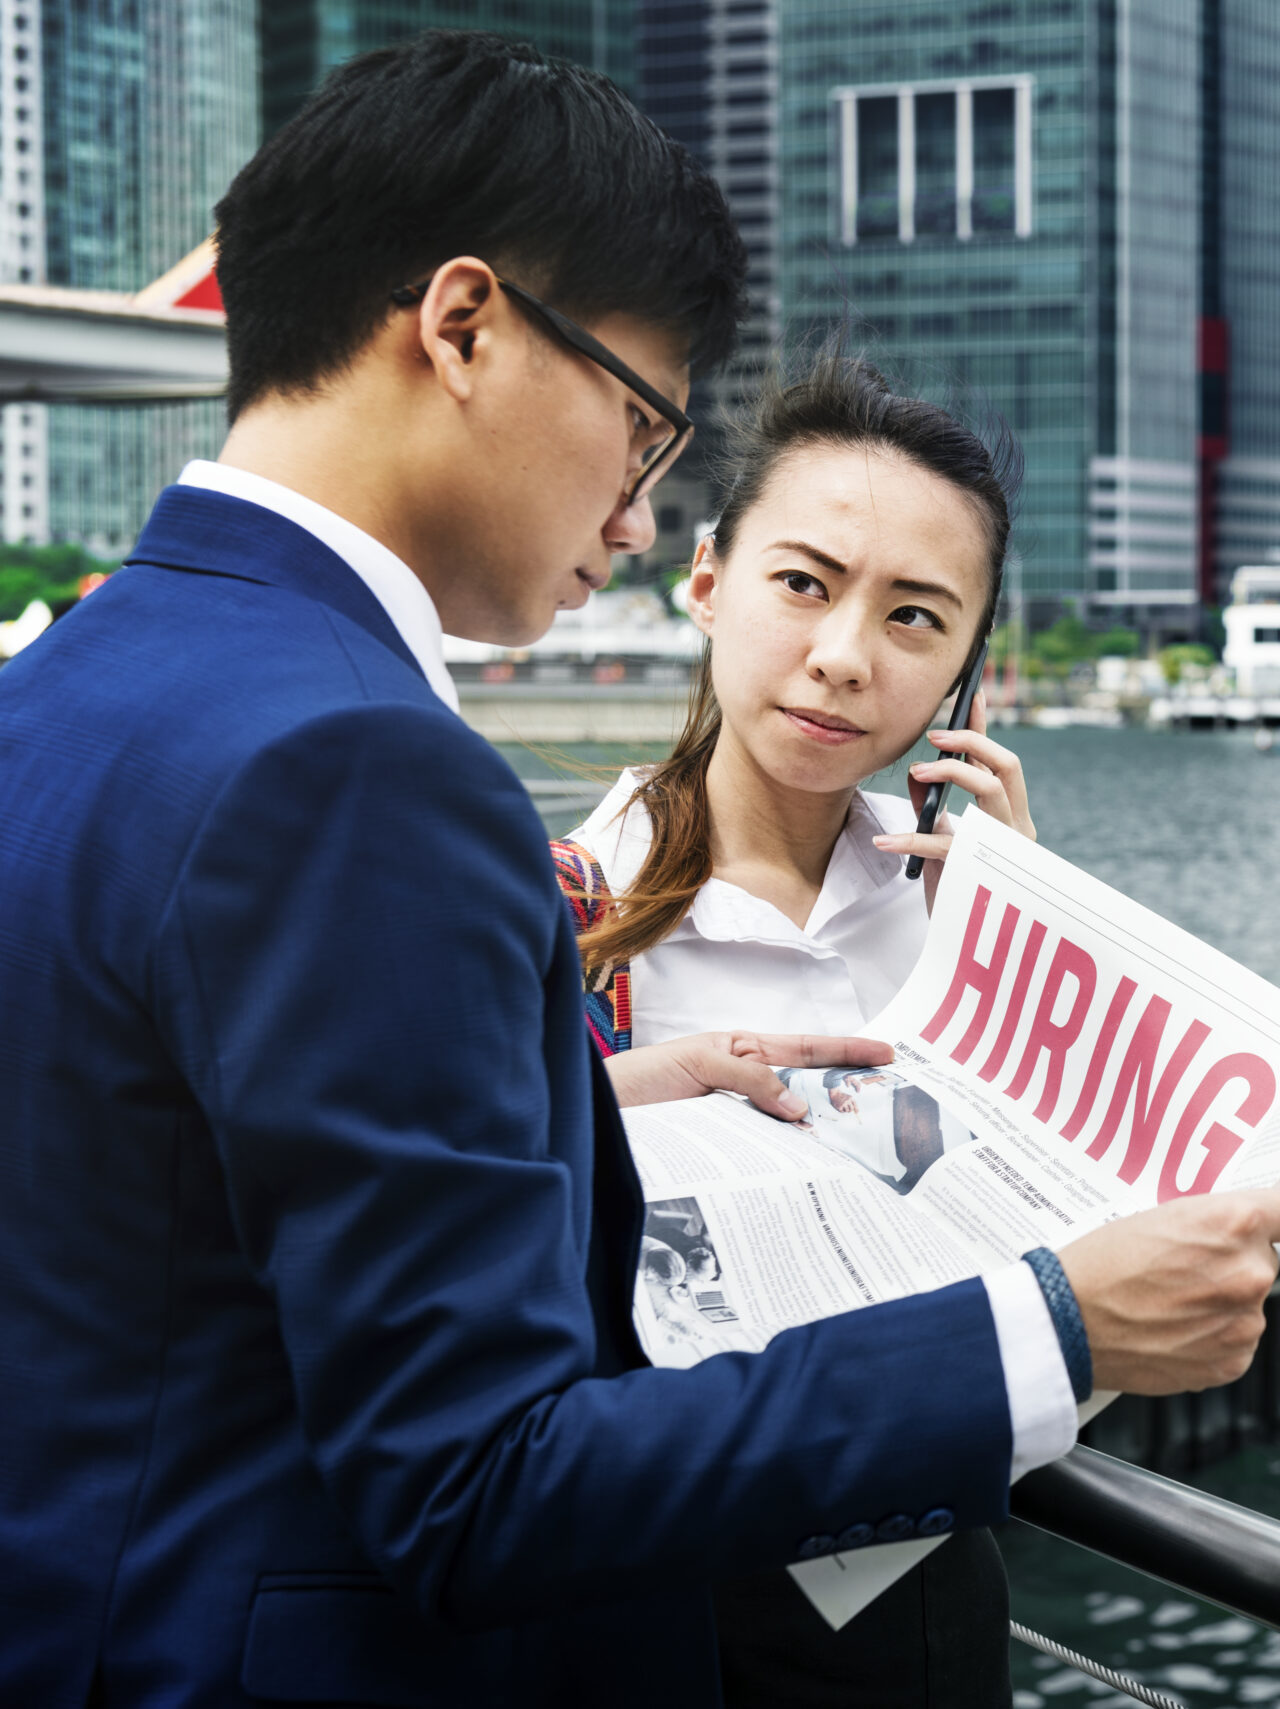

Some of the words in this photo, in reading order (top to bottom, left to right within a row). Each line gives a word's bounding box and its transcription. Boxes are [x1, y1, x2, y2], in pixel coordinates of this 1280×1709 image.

[894, 1041, 931, 1064] EMPLOYMENT
[919, 884, 1276, 1204] HIRING
[972, 1149, 991, 1164] STAFF
[987, 1161, 998, 1171] FOR
[997, 1171, 1021, 1190] STARTUP
[1016, 1189, 1041, 1210] COMPANY
[981, 1146, 1006, 1166] URGENTLY
[1021, 1181, 1038, 1193] TEMP
[1033, 1193, 1075, 1226] ADMINISTRATIVE
